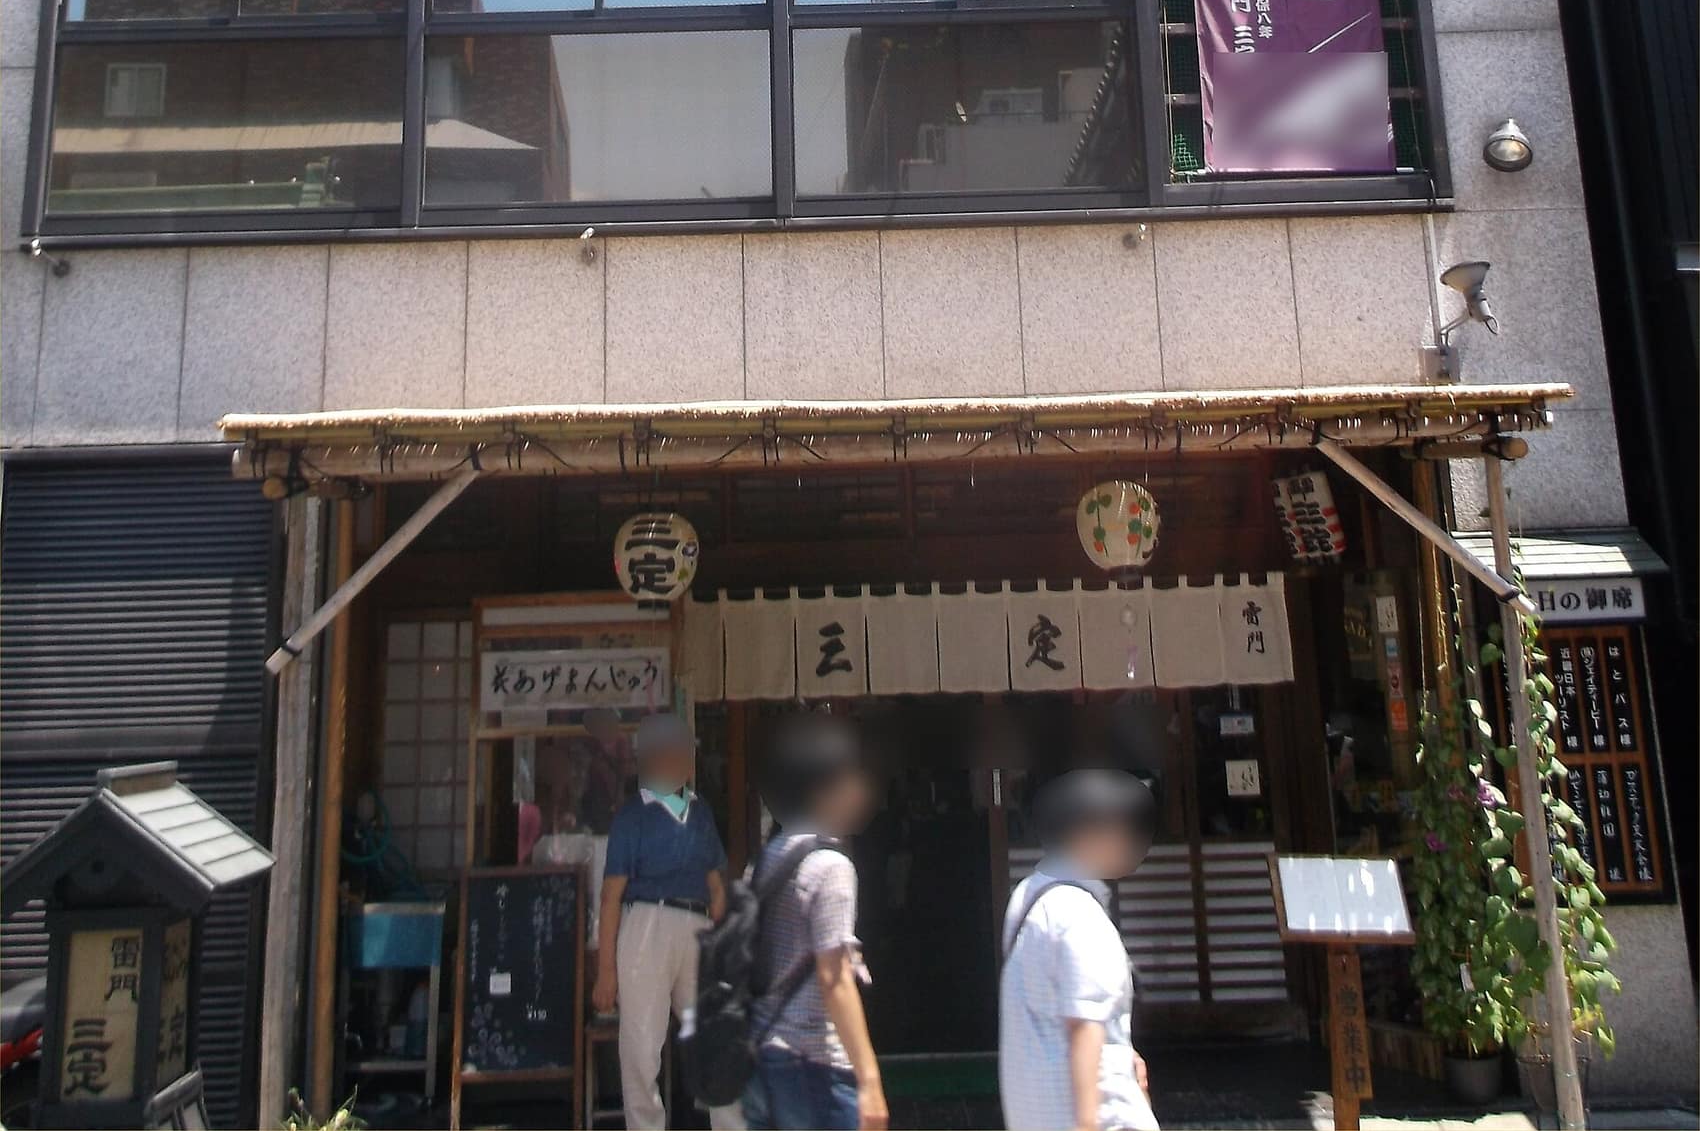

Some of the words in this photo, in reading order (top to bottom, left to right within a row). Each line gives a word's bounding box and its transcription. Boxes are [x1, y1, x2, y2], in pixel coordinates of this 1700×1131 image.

[624, 520, 680, 594] 三定
[1240, 600, 1266, 655] 雷門
[1526, 585, 1634, 613] 日の御席
[104, 936, 140, 1003] 雷門
[64, 1018, 113, 1096] 三定
